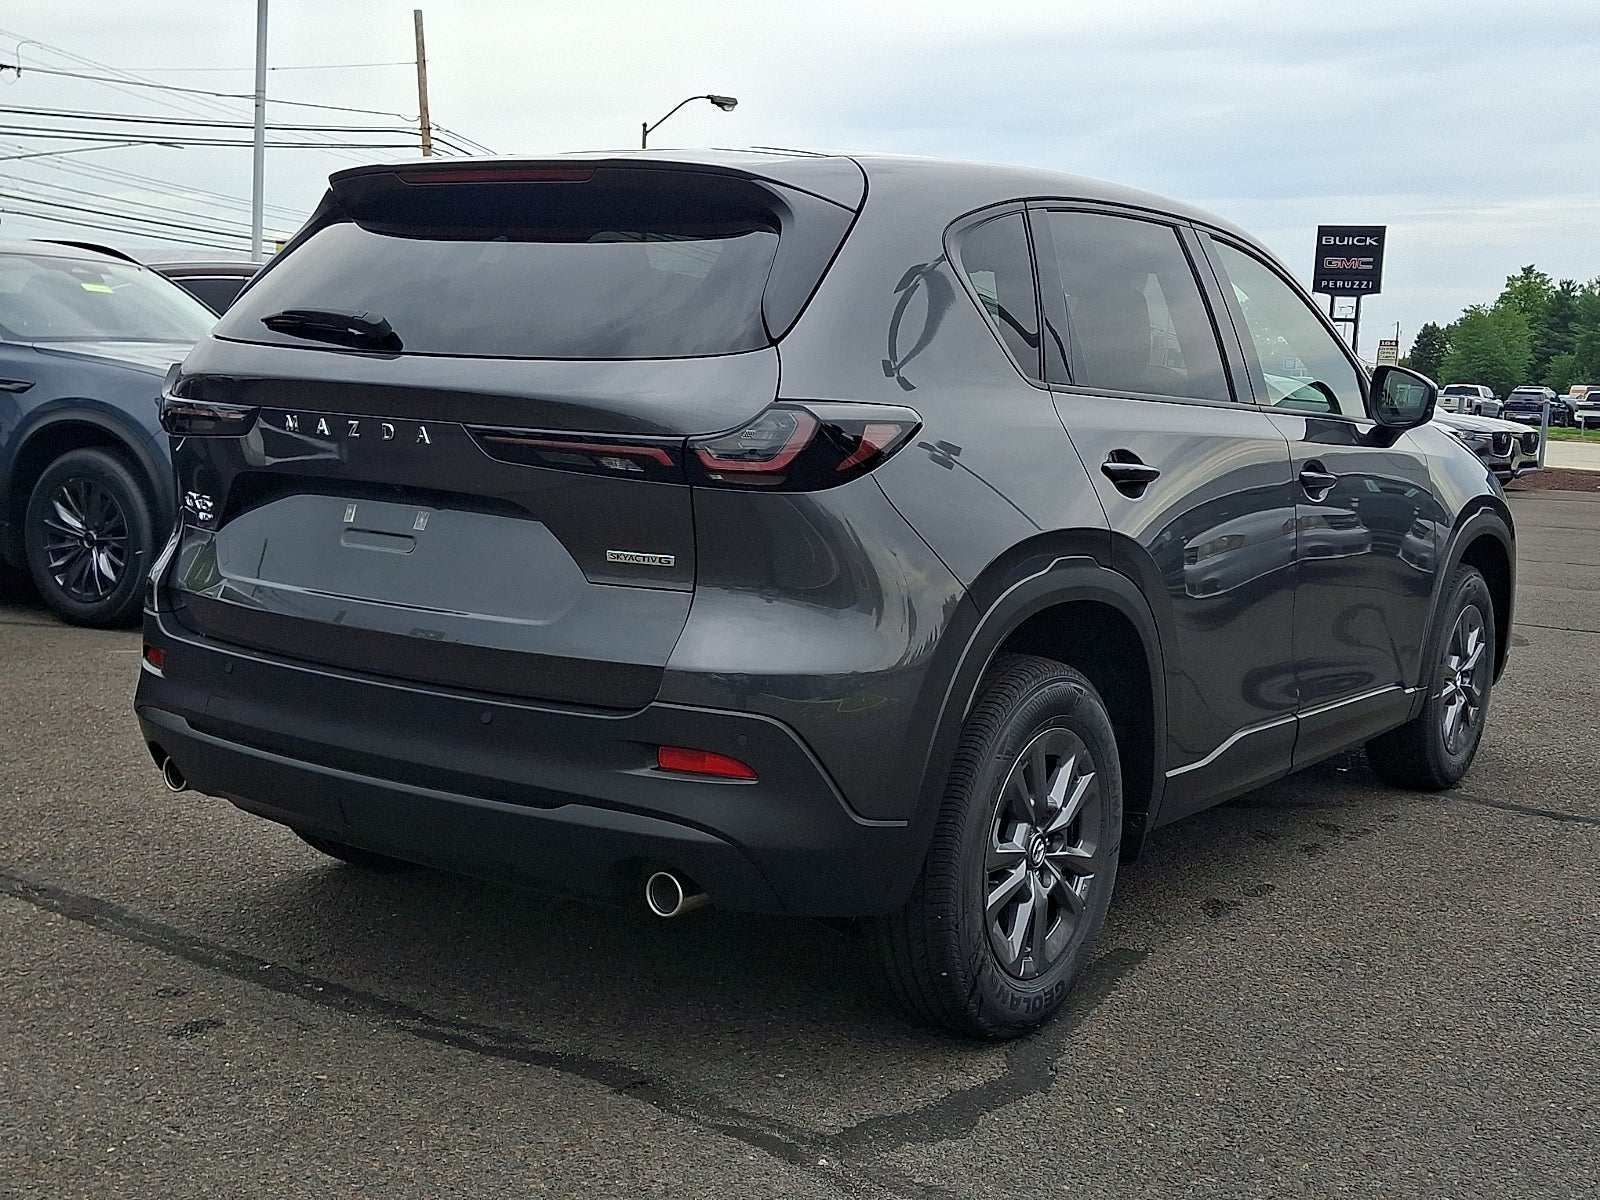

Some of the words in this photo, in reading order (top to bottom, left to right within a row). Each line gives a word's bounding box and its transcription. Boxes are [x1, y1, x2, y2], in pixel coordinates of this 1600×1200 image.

[1322, 236, 1379, 246] BUICK
[1323, 257, 1374, 269] GMC
[1321, 280, 1373, 289] PERUZZI
[285, 414, 432, 445] MAZDA
